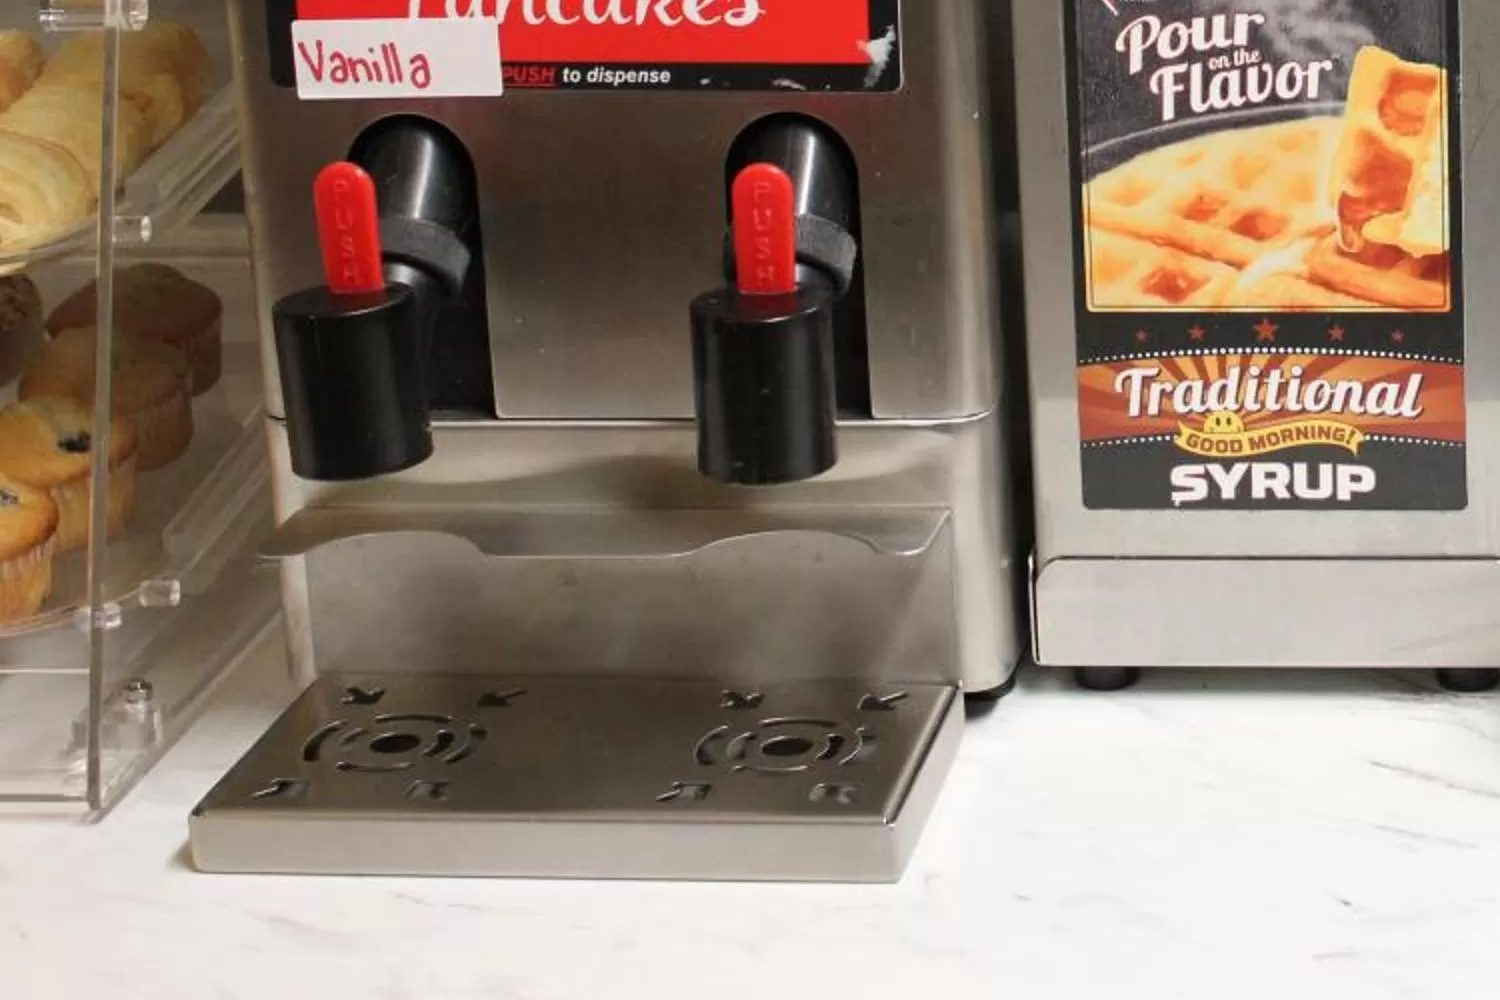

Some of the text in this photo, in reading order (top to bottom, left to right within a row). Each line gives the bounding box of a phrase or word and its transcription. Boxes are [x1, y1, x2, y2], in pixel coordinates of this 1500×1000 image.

[297, 39, 432, 90] Vanilla
[1115, 12, 1265, 76] Pour
[1208, 47, 1262, 70] on the
[503, 66, 672, 87] PUSH to dispense
[1149, 59, 1333, 122] Flavor
[1114, 365, 1424, 417] Traditional
[1186, 424, 1356, 453] GOOD MORNING!
[1171, 462, 1377, 507] SYRUP
